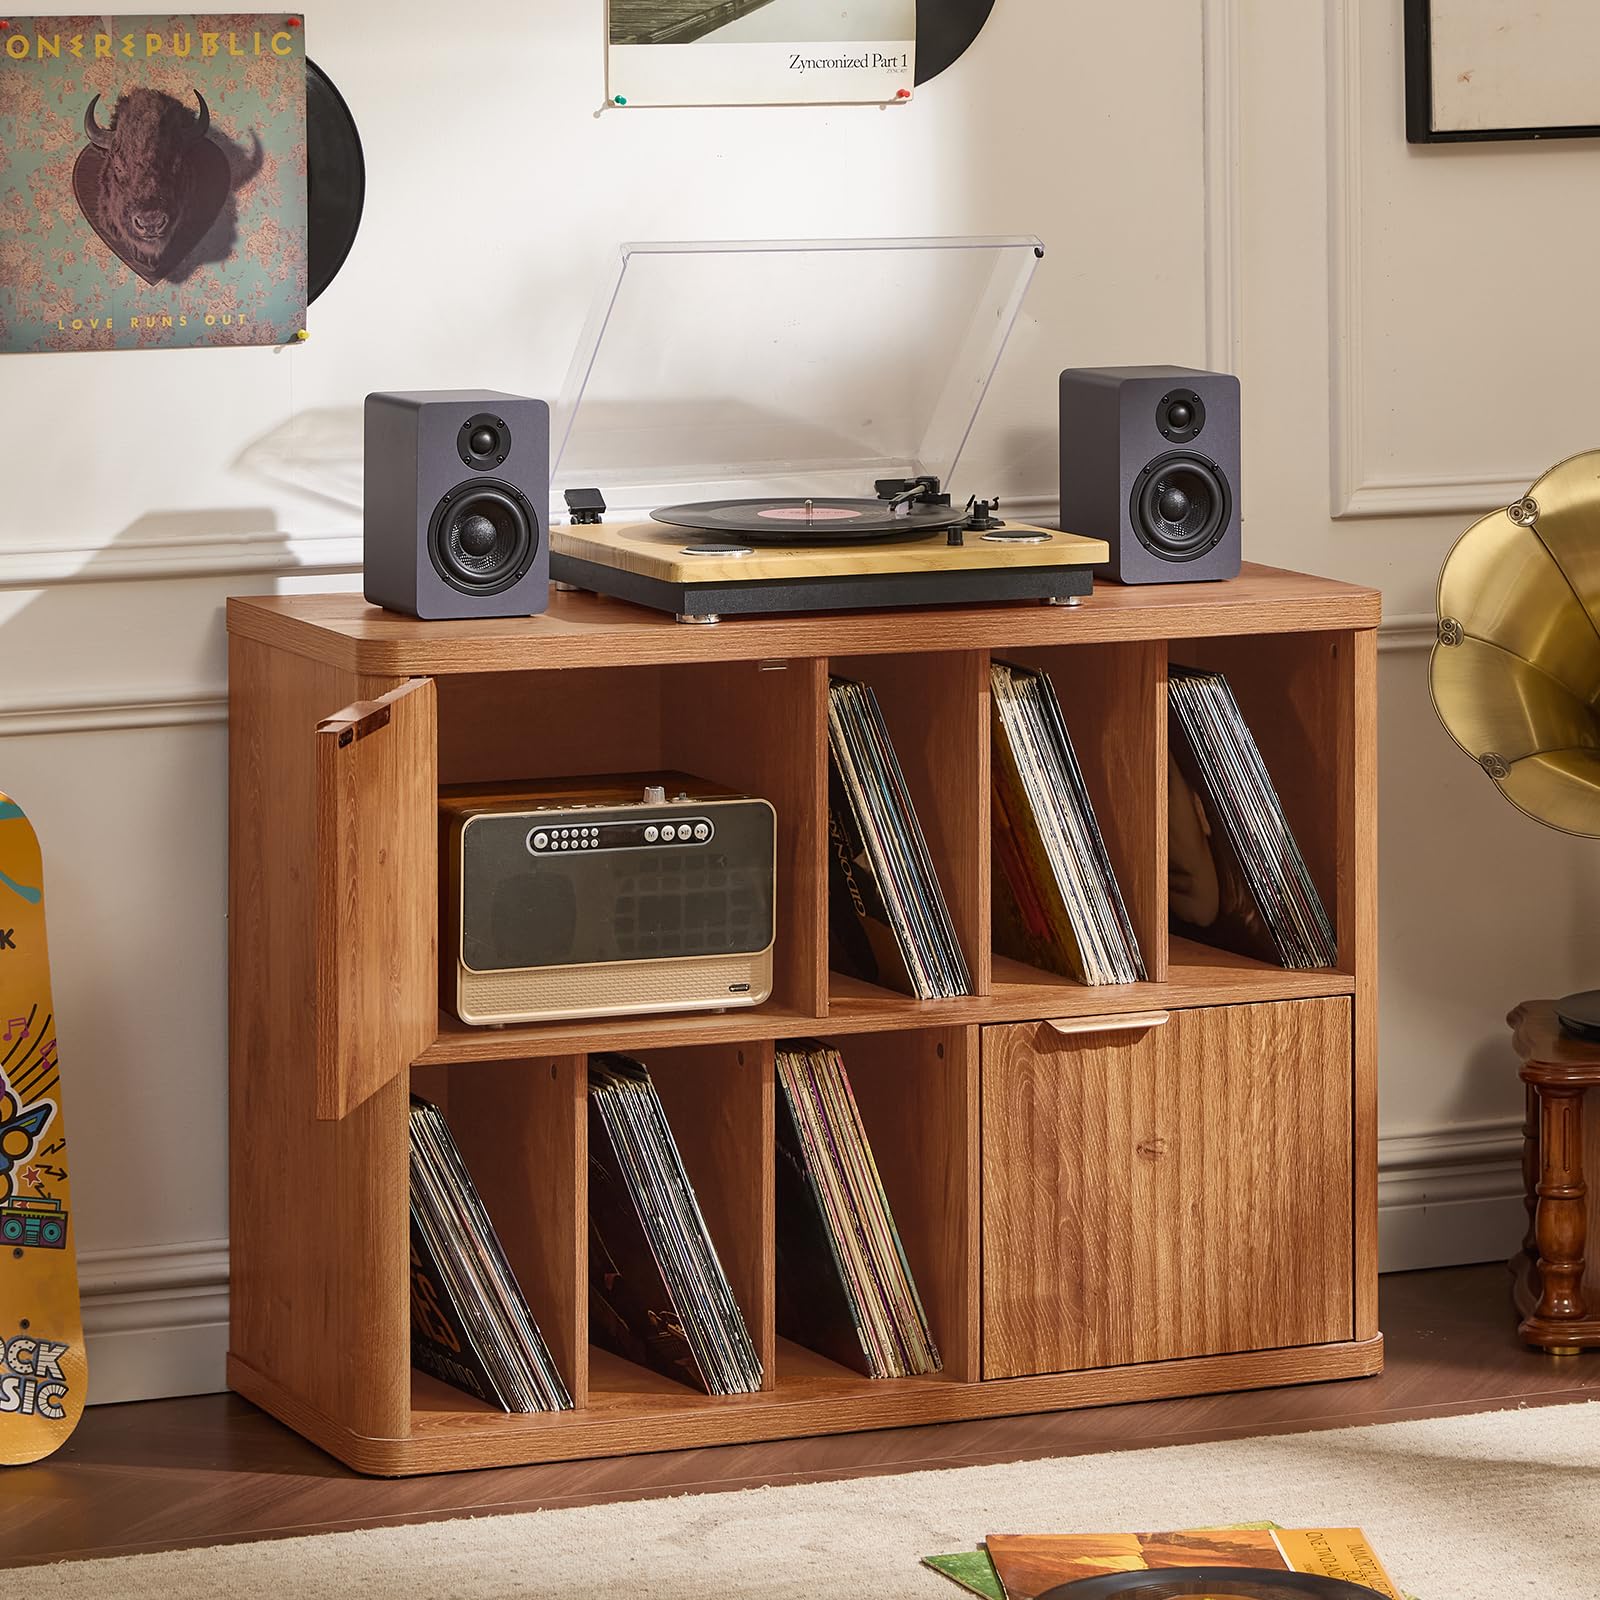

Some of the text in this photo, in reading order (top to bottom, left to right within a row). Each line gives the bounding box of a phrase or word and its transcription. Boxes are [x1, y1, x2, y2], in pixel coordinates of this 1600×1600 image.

[6, 31, 293, 59] ONEREPUBLIC
[789, 53, 908, 74] Zyncronized Part 1
[58, 313, 246, 330] LOVE RUNS OUT
[834, 843, 867, 918] GIDON
[0, 1337, 69, 1380] CK
